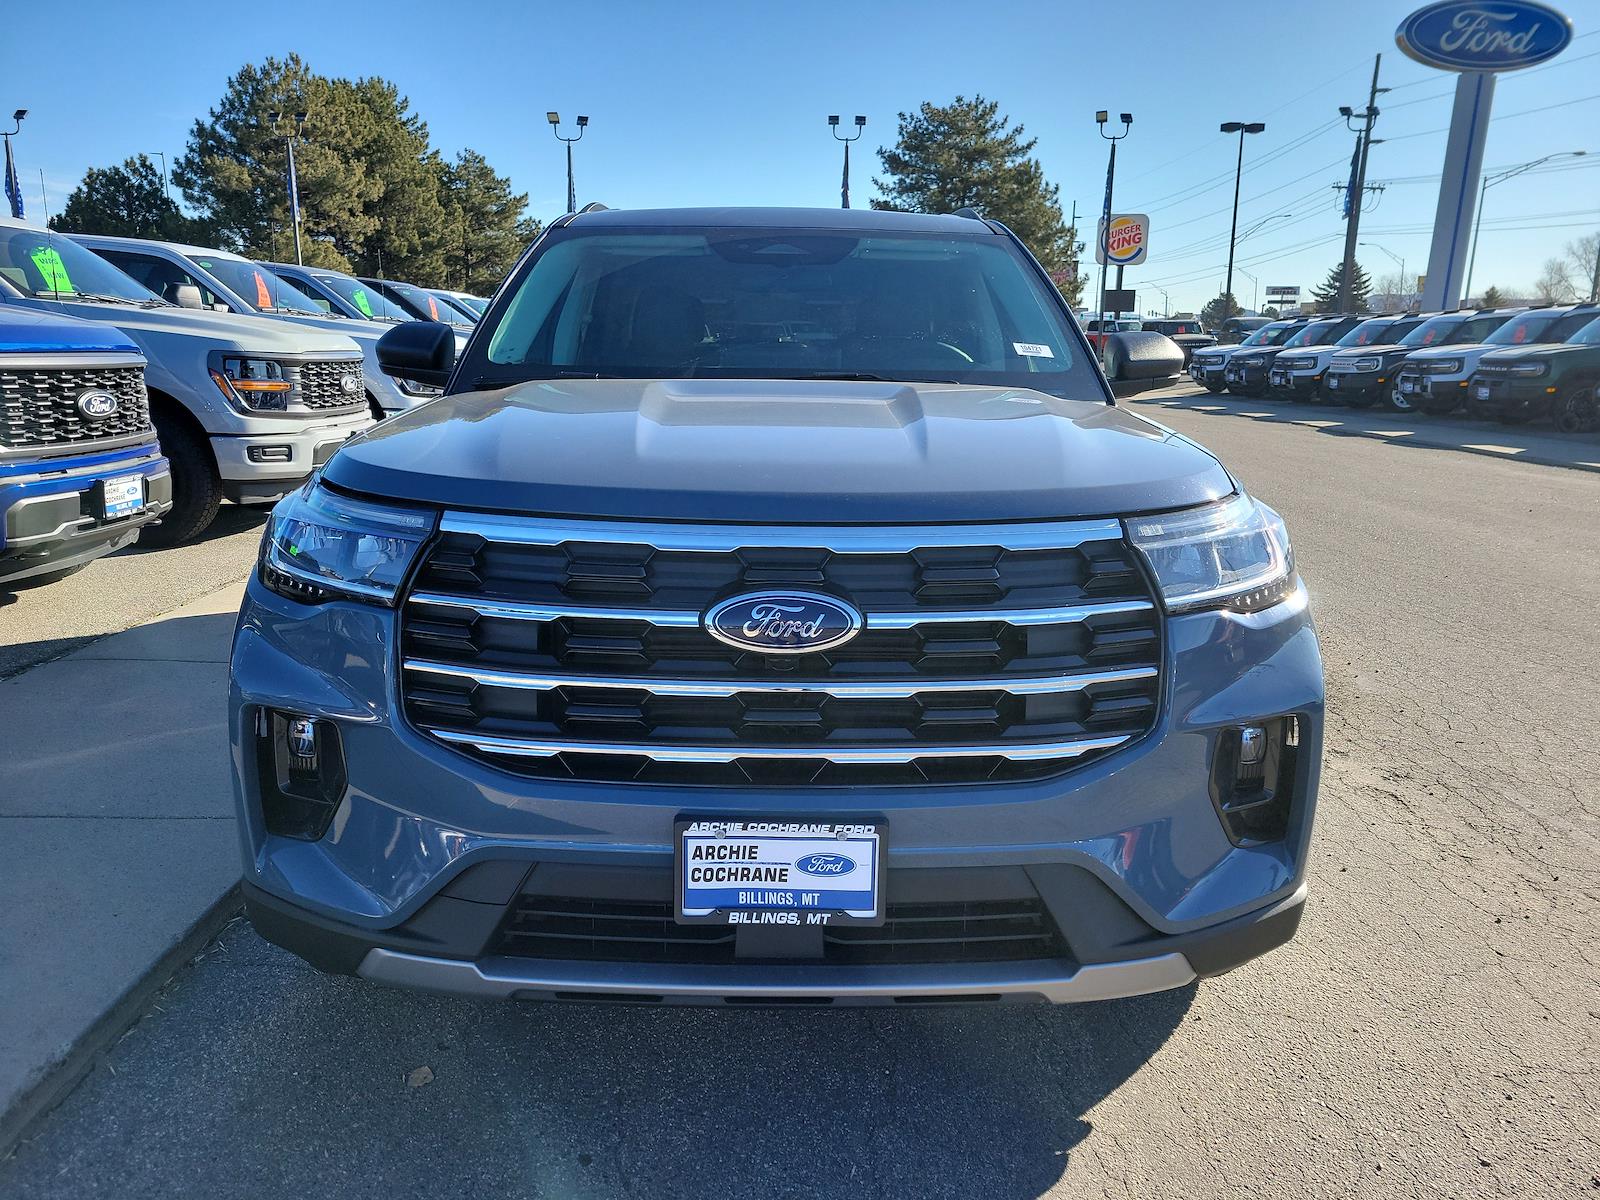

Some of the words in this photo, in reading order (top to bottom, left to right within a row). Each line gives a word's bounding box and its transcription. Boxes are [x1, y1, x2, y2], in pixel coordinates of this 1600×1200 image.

[1440, 9, 1542, 54] Ford
[1107, 224, 1142, 240] URGER
[1106, 232, 1142, 251] KING
[90, 397, 111, 413] Ford
[742, 603, 826, 638] Ford
[688, 822, 743, 833] ARCHIE
[747, 823, 830, 834] COCHRANE
[834, 825, 875, 835] FORD
[691, 845, 759, 861] ARCHIE
[806, 856, 844, 874] Ford
[691, 867, 789, 883] COCHRANE
[738, 891, 798, 907] BILLINGS,
[801, 893, 820, 906] MT
[728, 912, 801, 926] BILLINGS,
[806, 913, 832, 925] MT
